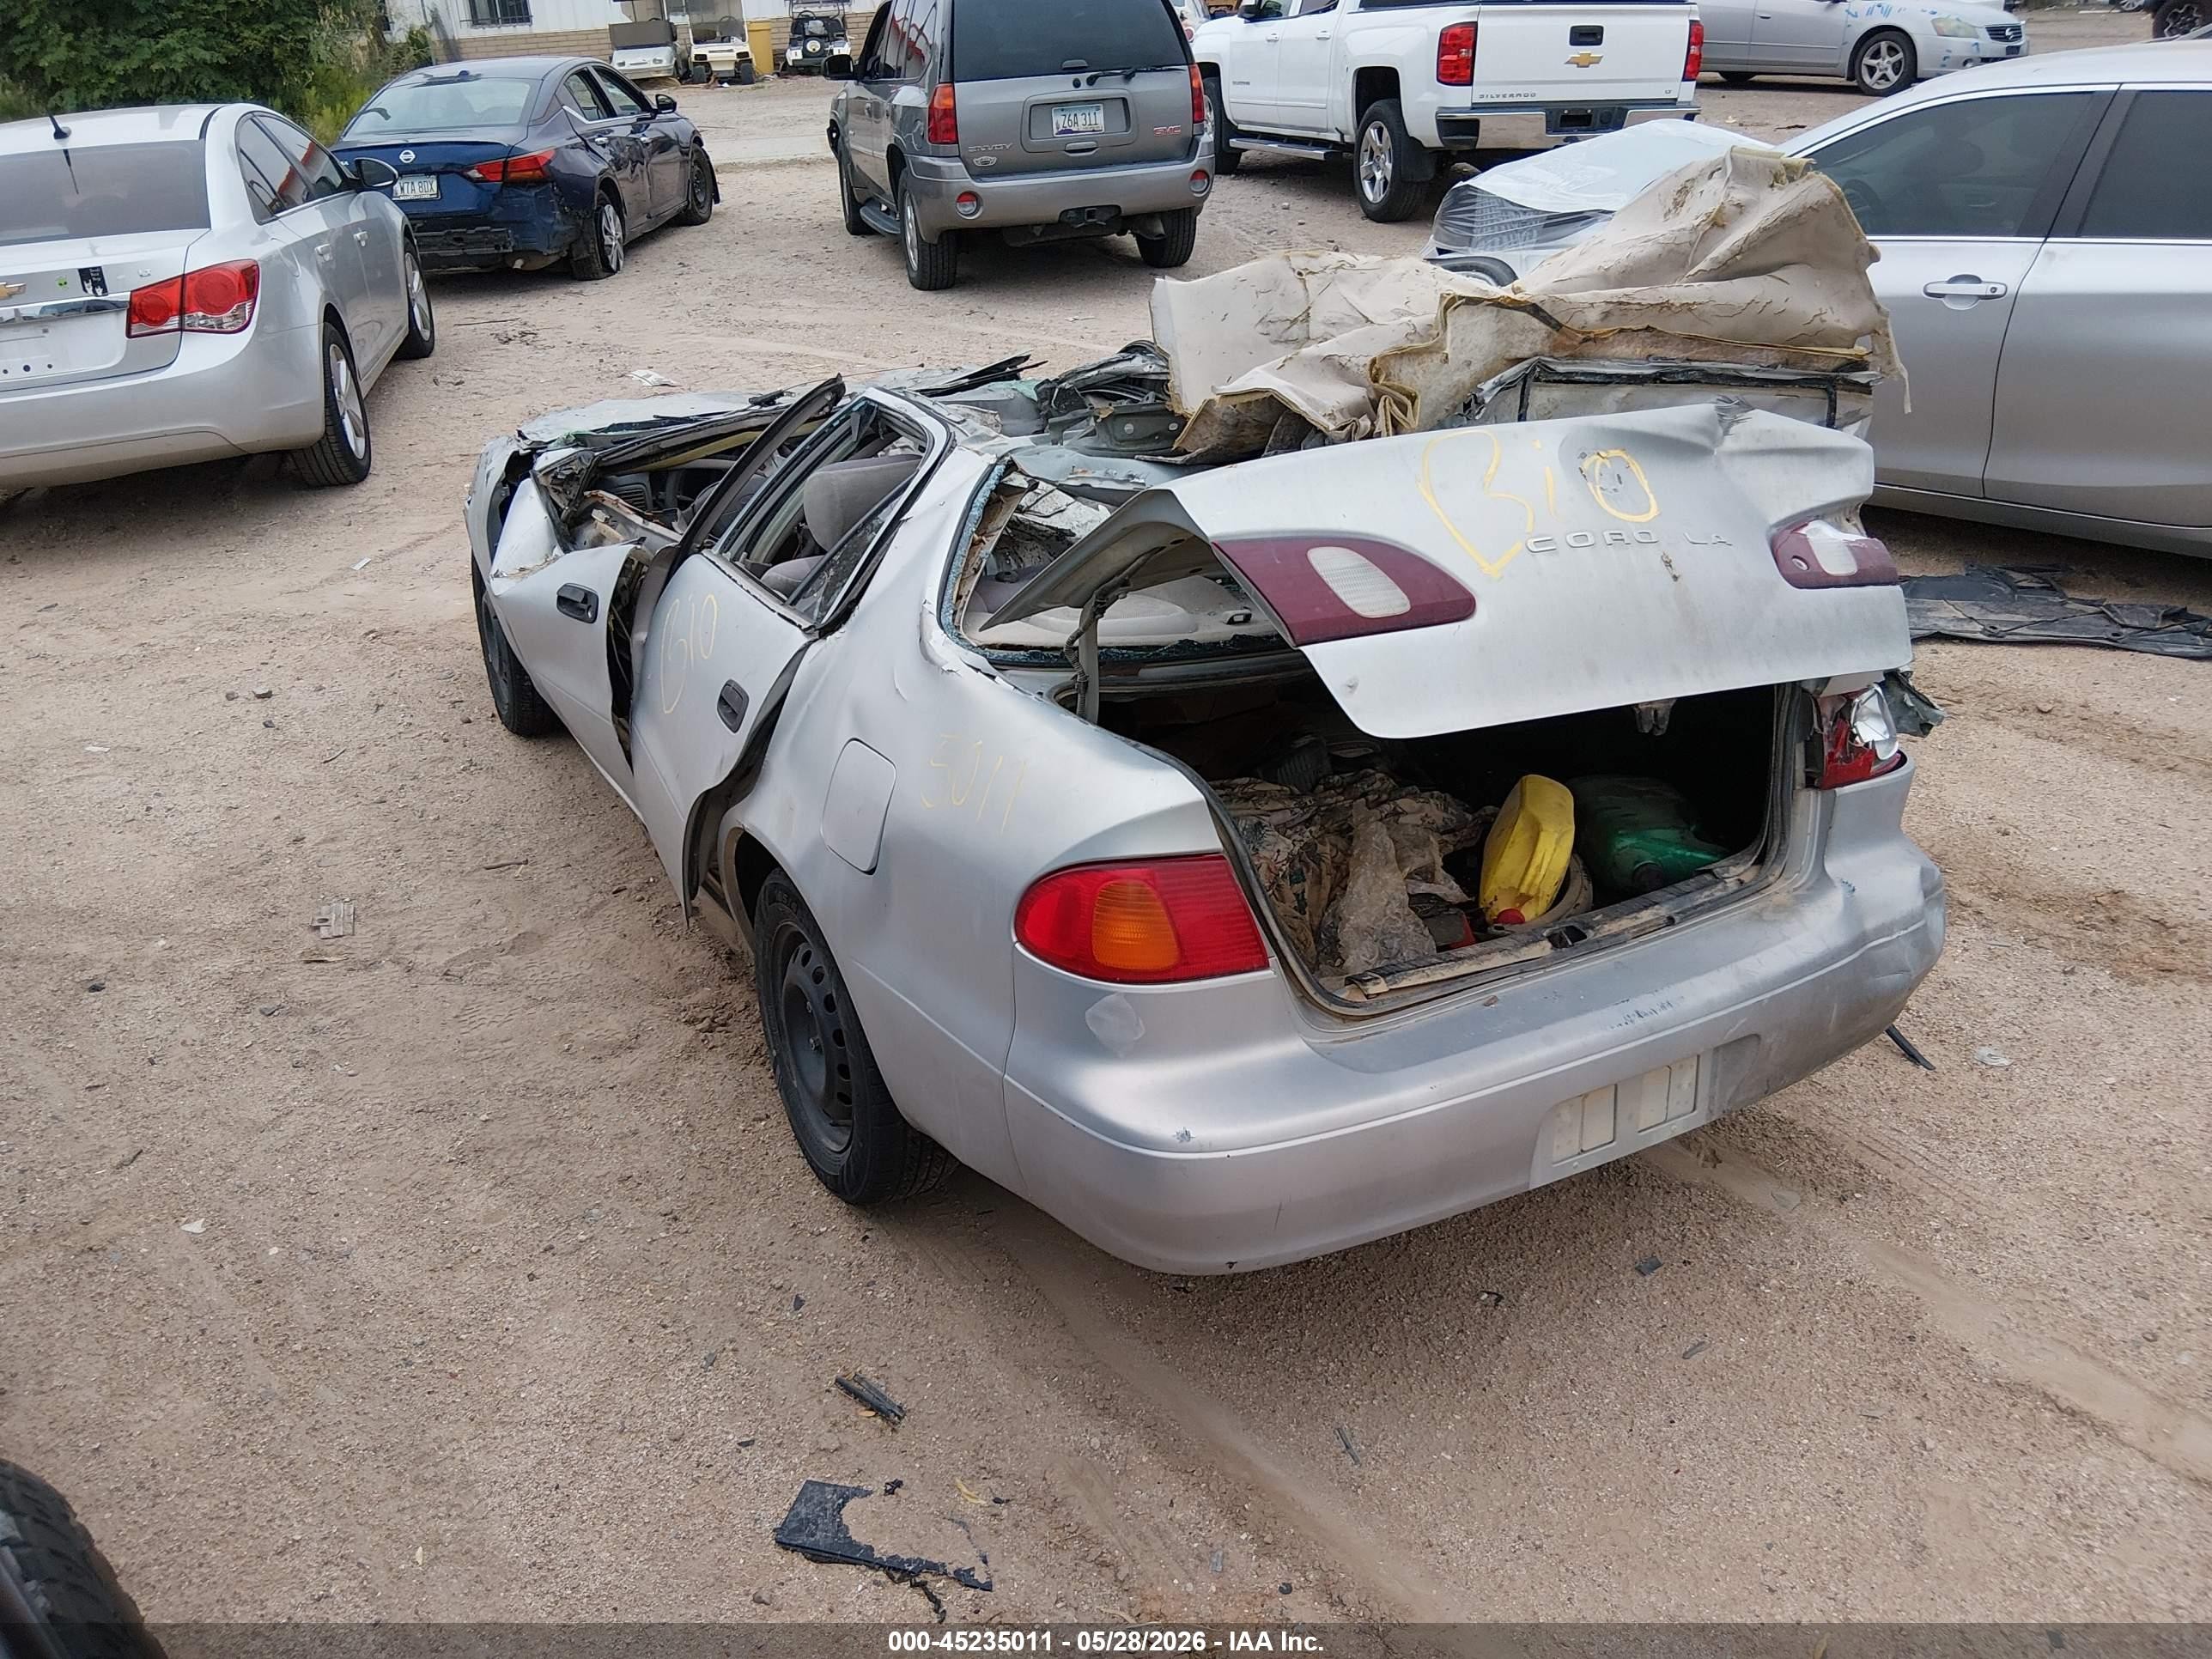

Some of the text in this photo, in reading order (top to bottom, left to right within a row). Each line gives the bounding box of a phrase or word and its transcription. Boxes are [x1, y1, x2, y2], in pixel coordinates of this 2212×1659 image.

[1060, 113, 1079, 129] Z6A
[1153, 125, 1182, 137] GMC
[968, 143, 1013, 152] ENVOY
